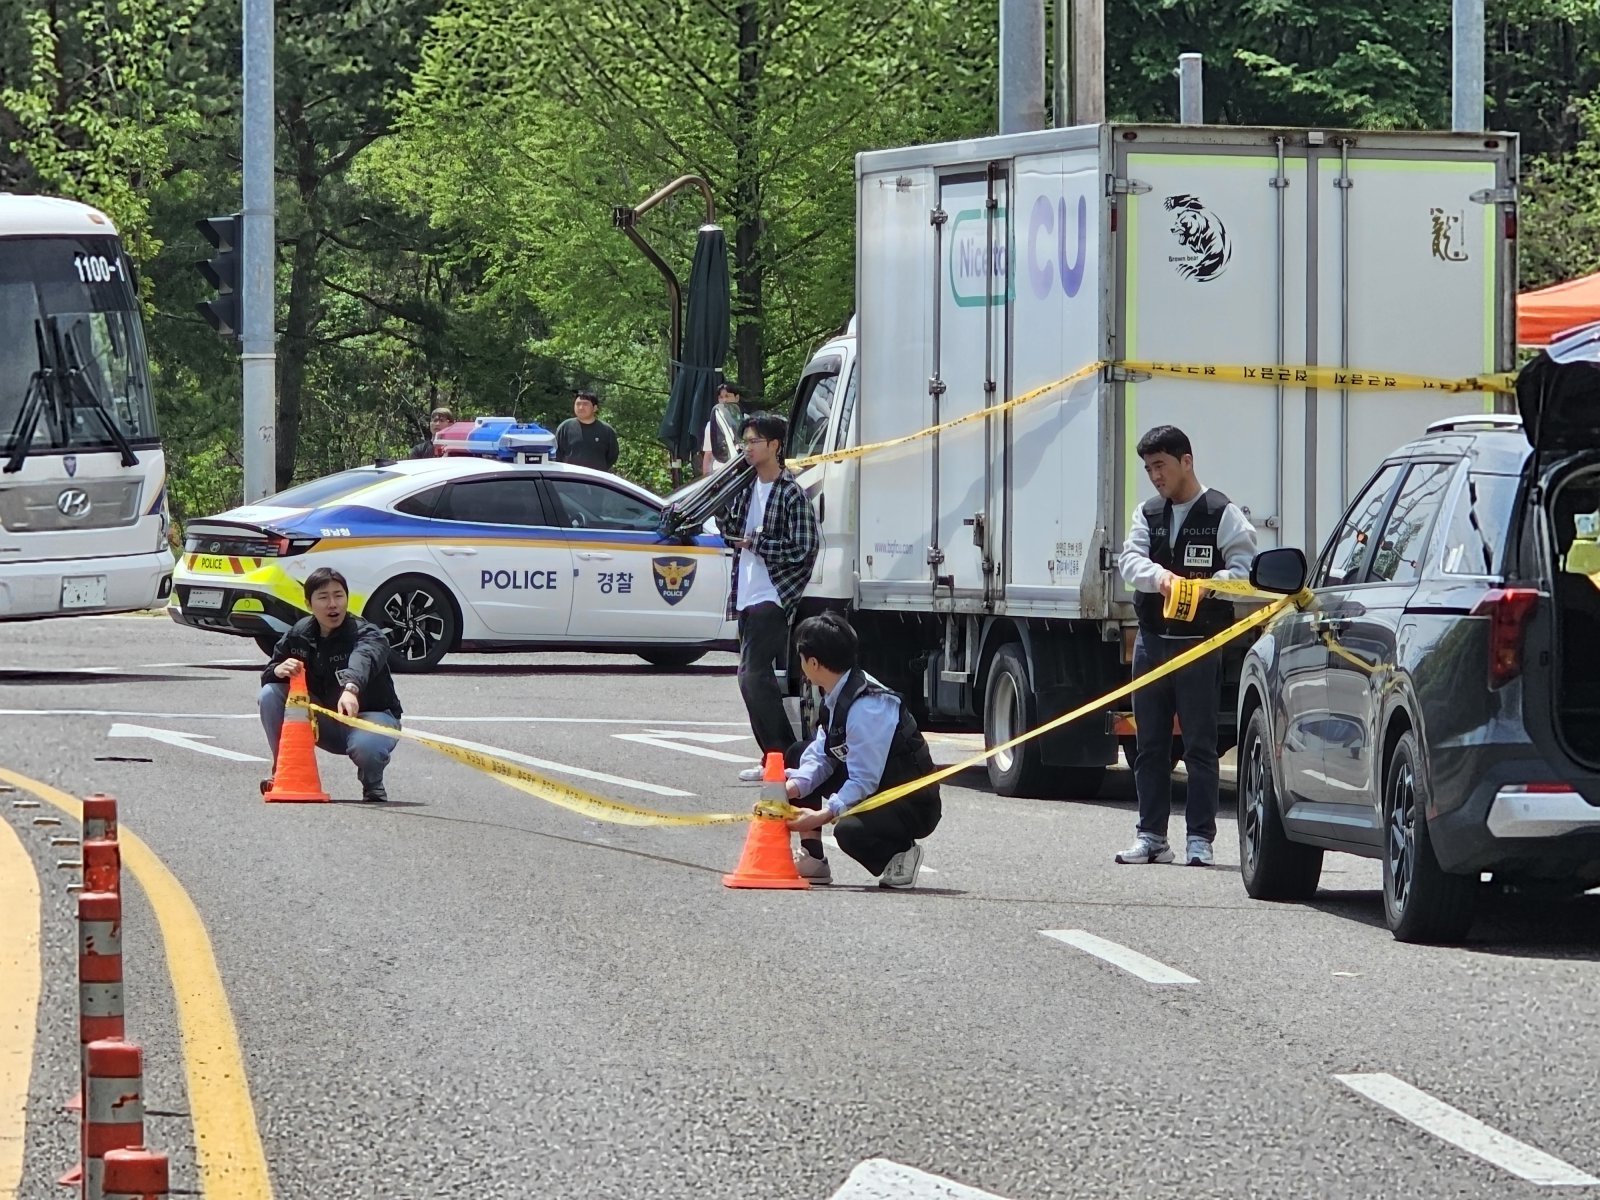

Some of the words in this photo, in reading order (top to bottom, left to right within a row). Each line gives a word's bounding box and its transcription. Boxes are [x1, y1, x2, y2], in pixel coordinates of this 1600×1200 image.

[1027, 194, 1087, 300] CU
[74, 255, 125, 282] 1100-1
[1243, 365, 1308, 382] 접근금지
[1334, 372, 1397, 387] 접근금지
[1183, 527, 1217, 536] POLICE
[201, 557, 222, 569] POLICE
[481, 570, 557, 590] POLICE
[597, 572, 634, 594] 경찰
